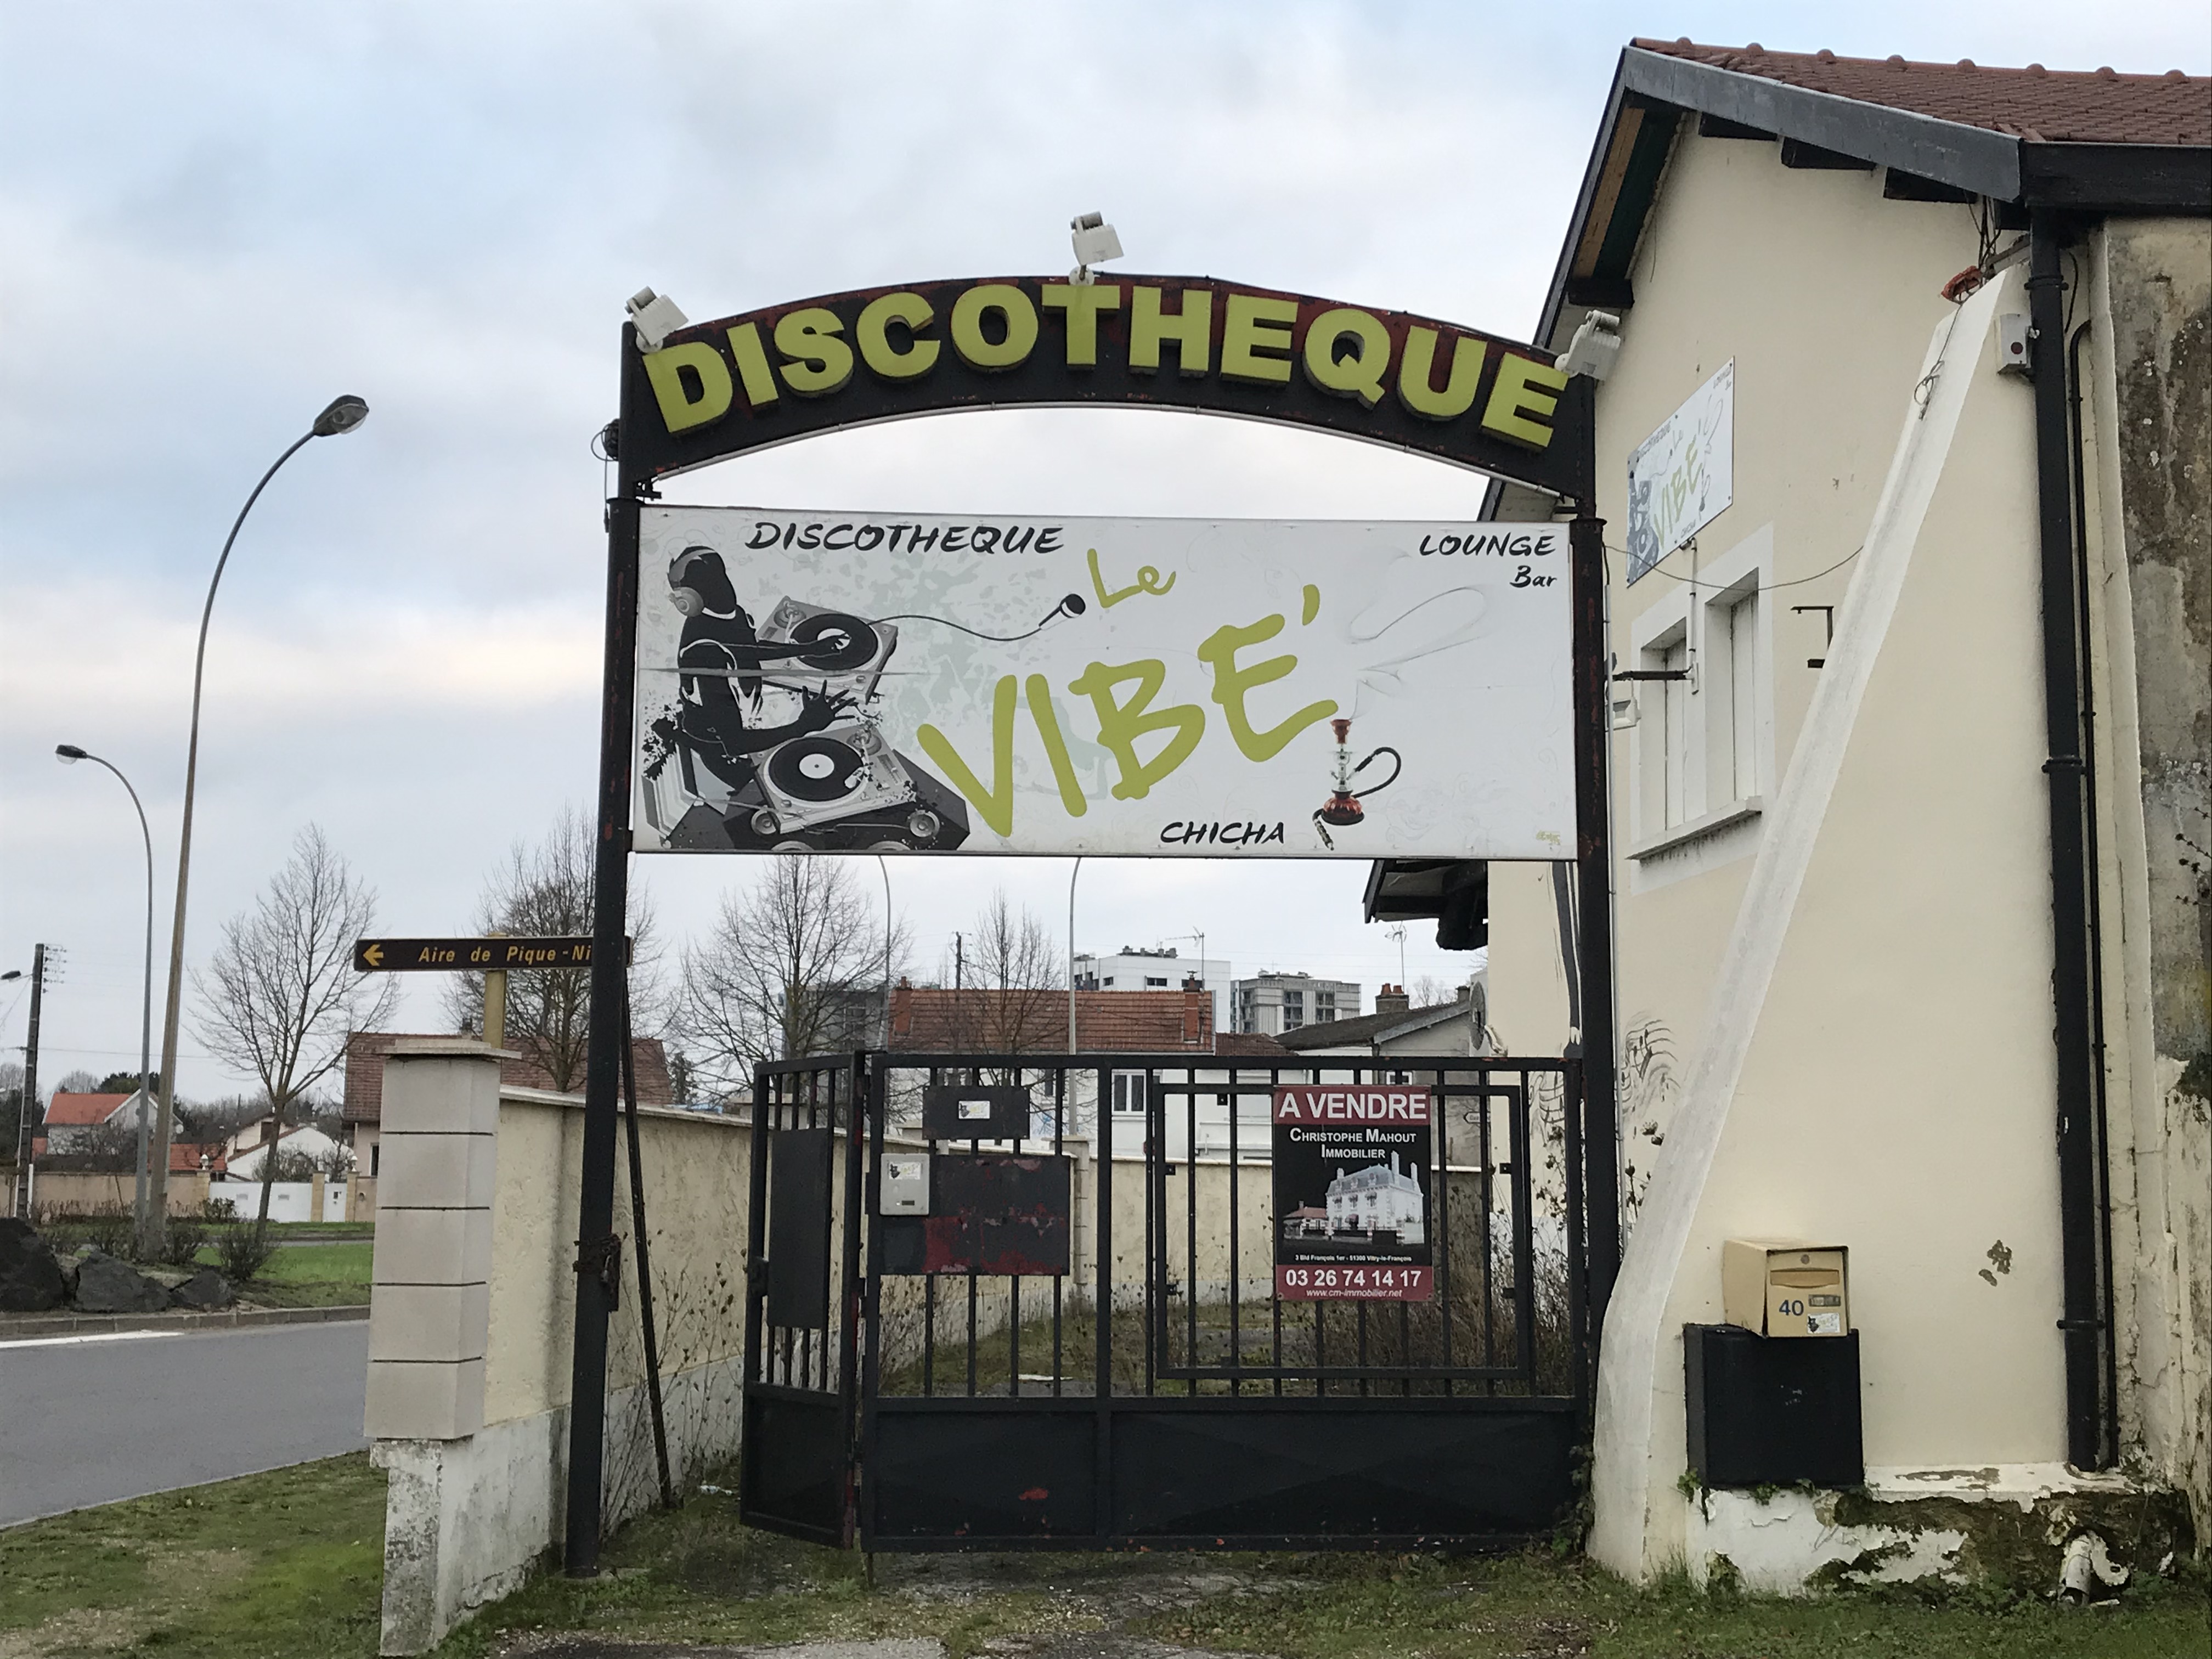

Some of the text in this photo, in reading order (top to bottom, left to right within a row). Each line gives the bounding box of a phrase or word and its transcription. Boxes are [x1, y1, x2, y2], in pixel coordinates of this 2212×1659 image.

[642, 283, 1569, 449] DISCOTHEQUE
[745, 522, 1064, 554] DISCOTHEQUE
[1419, 532, 1556, 556] LOUNGE
[1087, 549, 1176, 608] Le
[1509, 565, 1557, 588] Bar
[1160, 821, 1284, 845] CHICHA
[418, 945, 591, 966] Aire de Pique-Ni
[1279, 1093, 1426, 1119] A VENDRE
[1286, 1269, 1421, 1287] 03 26 74 14 17
[1306, 1289, 1402, 1297] www.cm-immobilier.net
[1779, 1299, 1804, 1316] 40
